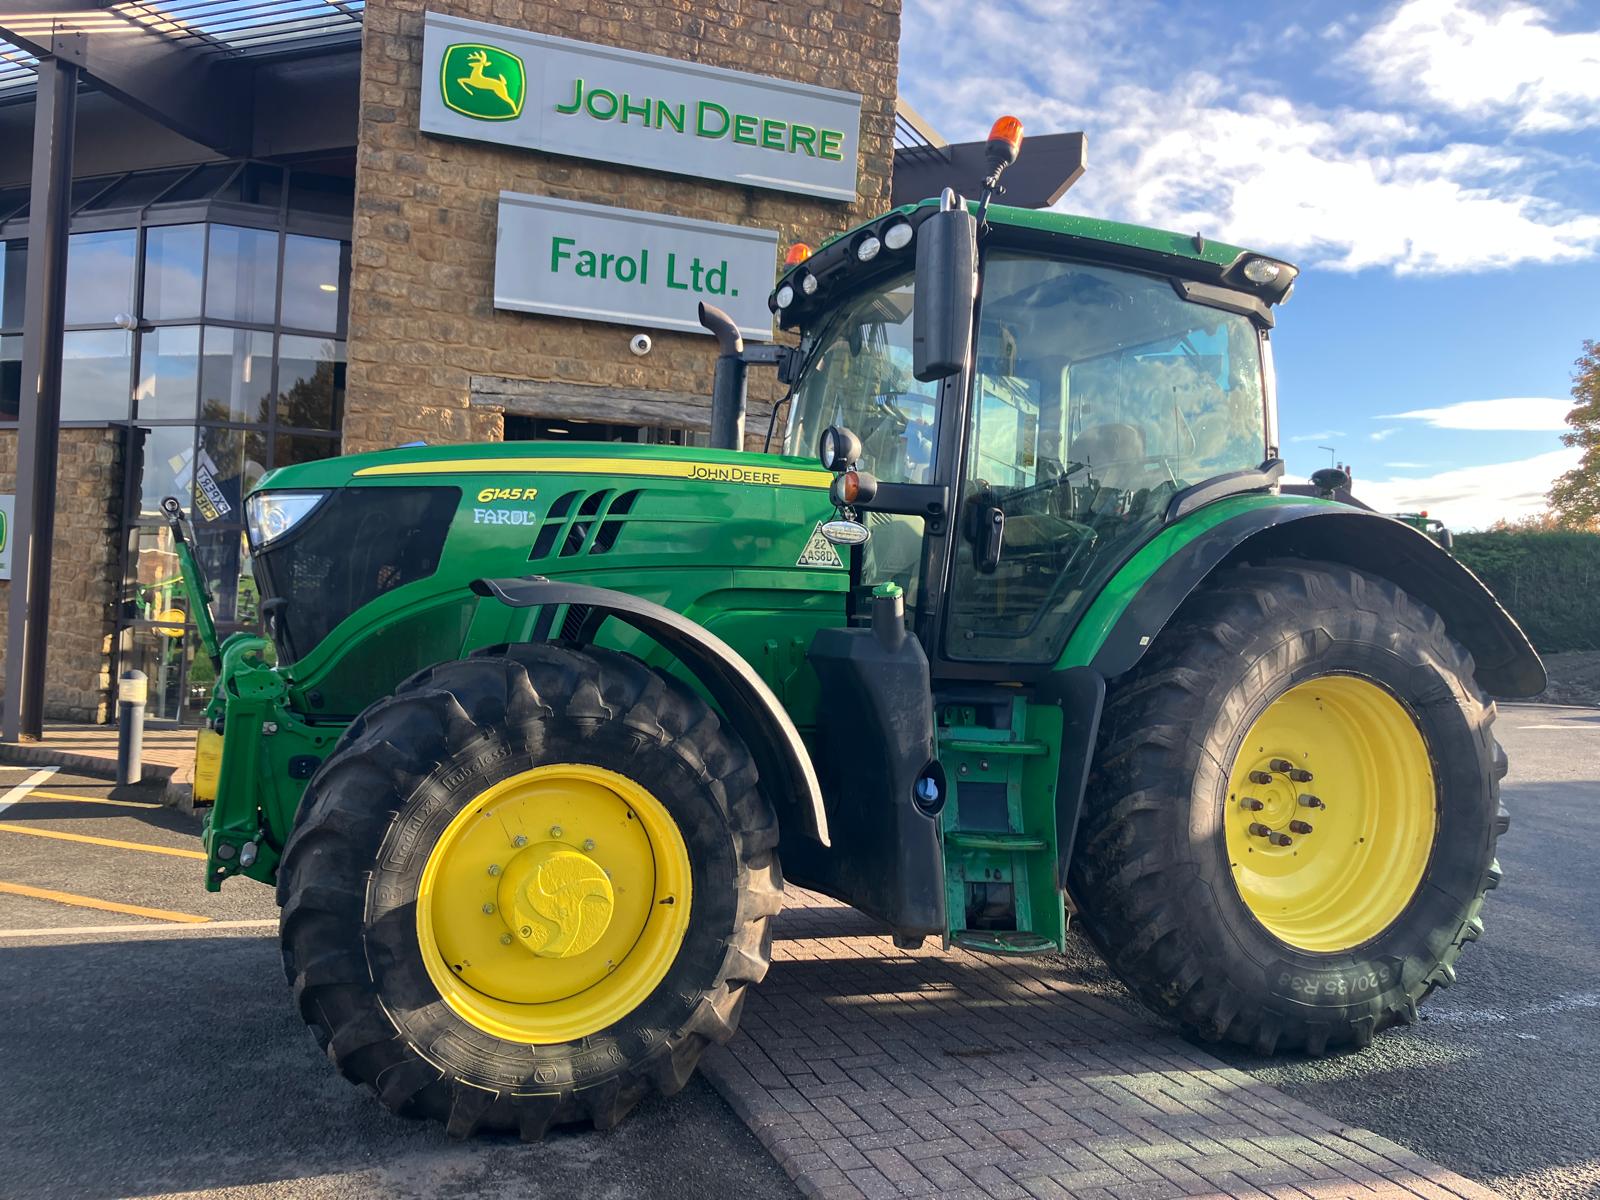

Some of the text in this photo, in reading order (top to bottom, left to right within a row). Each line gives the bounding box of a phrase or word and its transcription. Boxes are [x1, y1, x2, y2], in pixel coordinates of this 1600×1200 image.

[554, 78, 846, 162] JOHN DEERE
[551, 236, 739, 297] Farol Ltd.
[687, 465, 781, 484] JOHN DEERE
[473, 507, 537, 526] FAROL
[814, 538, 827, 551] 22
